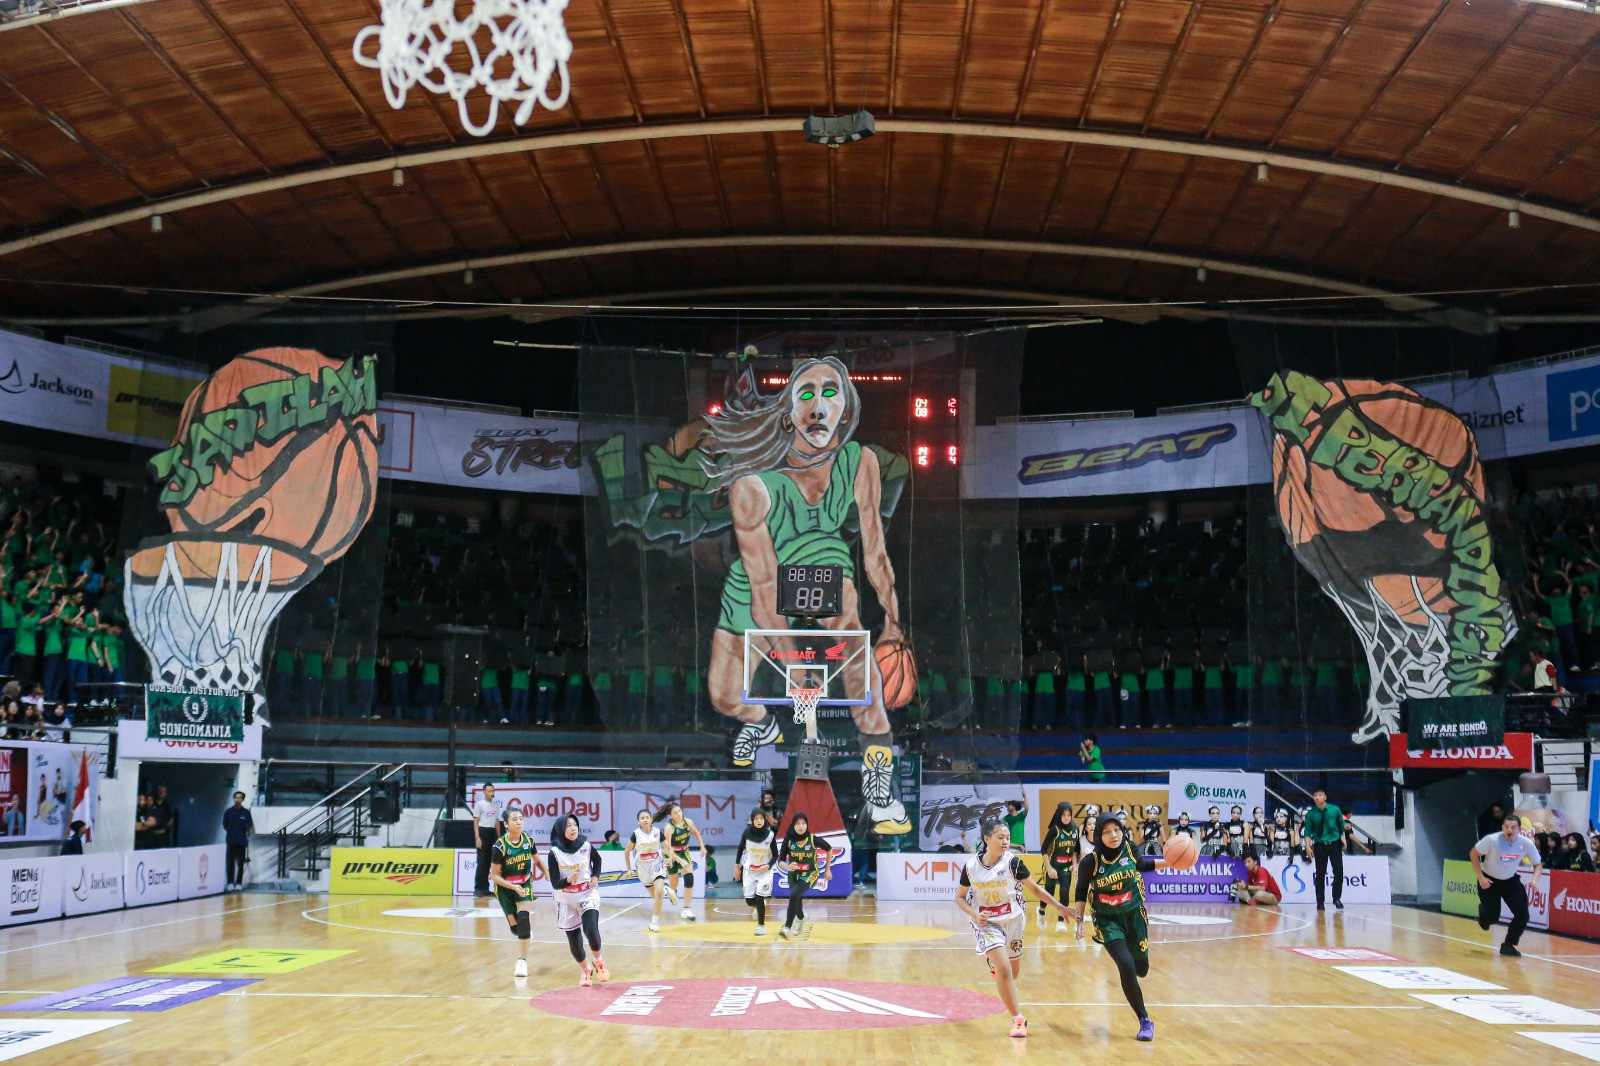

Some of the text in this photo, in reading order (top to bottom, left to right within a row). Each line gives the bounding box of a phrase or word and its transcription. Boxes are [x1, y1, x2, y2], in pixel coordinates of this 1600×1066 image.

[30, 373, 94, 400] Jackson
[474, 427, 558, 438] BEAT
[1020, 425, 1235, 482] BEAT
[188, 686, 207, 695] JUST
[191, 702, 199, 715] 9
[816, 709, 850, 718] TRIBUNE
[159, 723, 232, 738] SONGOMANIA
[1440, 722, 1458, 733] ARE
[1199, 787, 1247, 799] RS UBAYA
[562, 796, 600, 822] Day
[342, 861, 439, 876] proteam
[1200, 864, 1233, 876] MILK
[90, 872, 118, 891] Jackson
[148, 869, 170, 886] Biznet
[1097, 869, 1135, 888] SEMBILAN
[1149, 884, 1208, 895] BLUEBERRY
